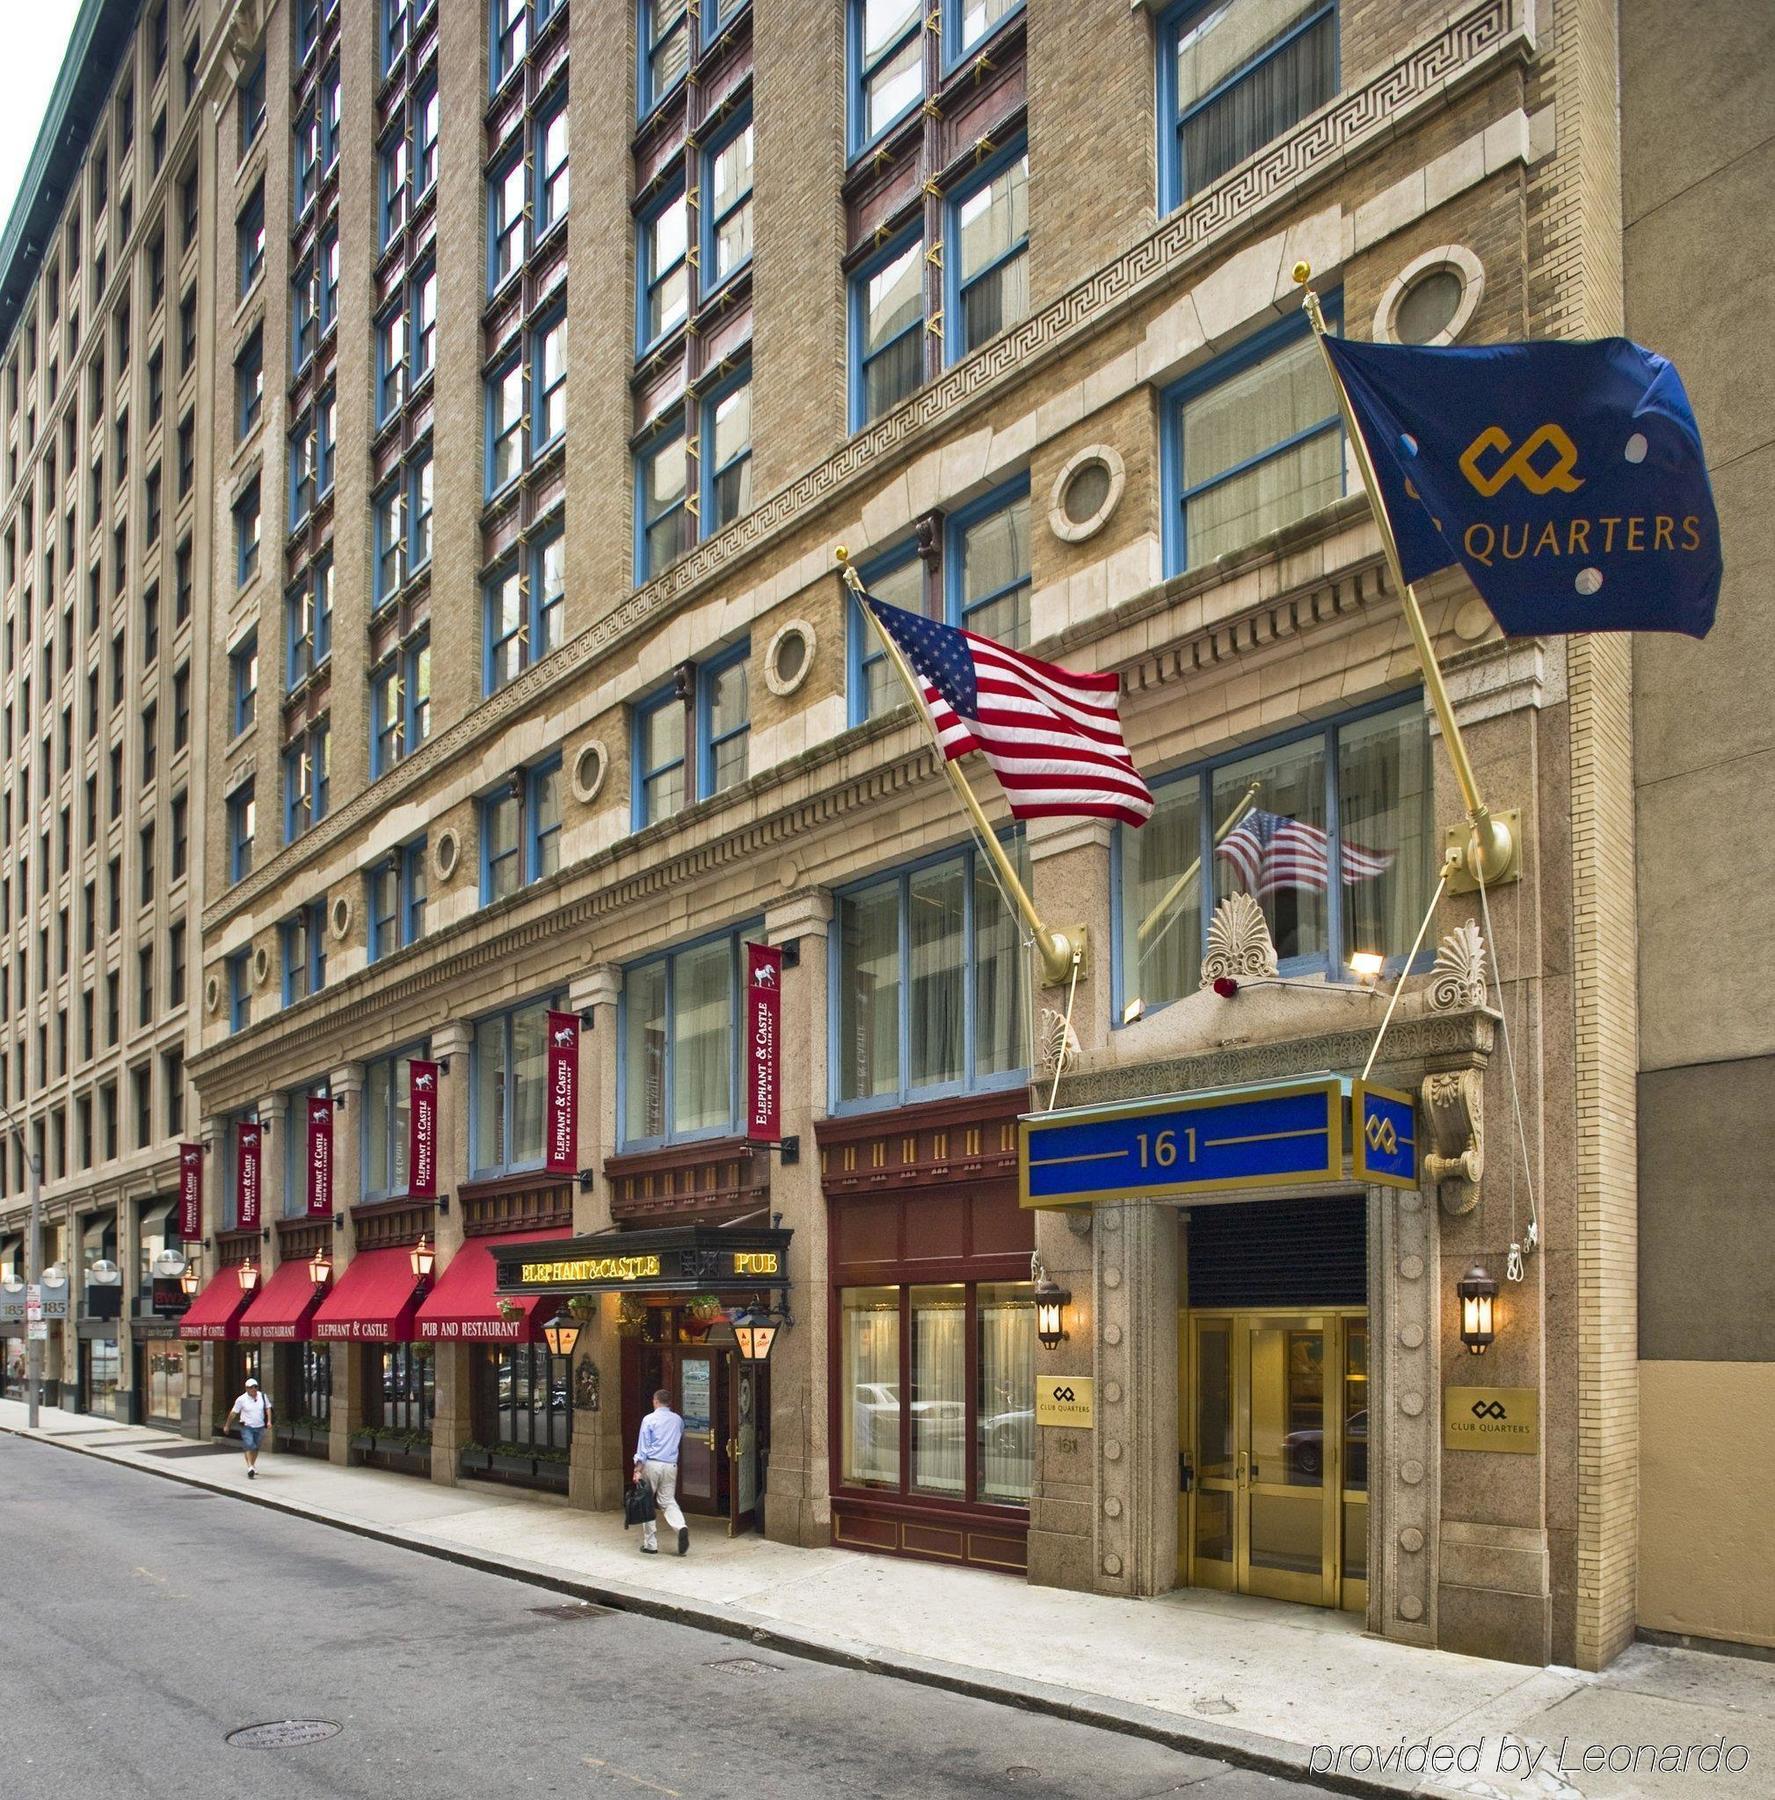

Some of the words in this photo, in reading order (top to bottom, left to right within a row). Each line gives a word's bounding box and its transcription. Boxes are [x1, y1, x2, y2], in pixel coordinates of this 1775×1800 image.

[1463, 516, 1700, 567] QUARTERS
[756, 1047, 767, 1060] &
[555, 1096, 565, 1107] &
[417, 1131, 426, 1141] &
[1136, 1127, 1197, 1168] 161
[313, 1160, 322, 1168] &
[737, 1253, 778, 1274] PUB
[42, 1301, 66, 1313] 185
[180, 1326, 201, 1336] ELEPHANT
[208, 1326, 225, 1336] CASTLE
[240, 1326, 250, 1337] PUB
[251, 1326, 262, 1337] AND
[263, 1325, 295, 1337] RESTAURANT
[318, 1324, 350, 1336] ELEPHANT
[352, 1321, 360, 1336] &
[362, 1323, 388, 1336] CASTLE
[422, 1323, 437, 1336] PUB
[441, 1323, 458, 1336] AND
[462, 1322, 520, 1337] RESTAURANT
[1058, 1404, 1090, 1413] QUARTERS
[1451, 1422, 1476, 1431] CLUB
[1479, 1423, 1530, 1434] QUARTERS
